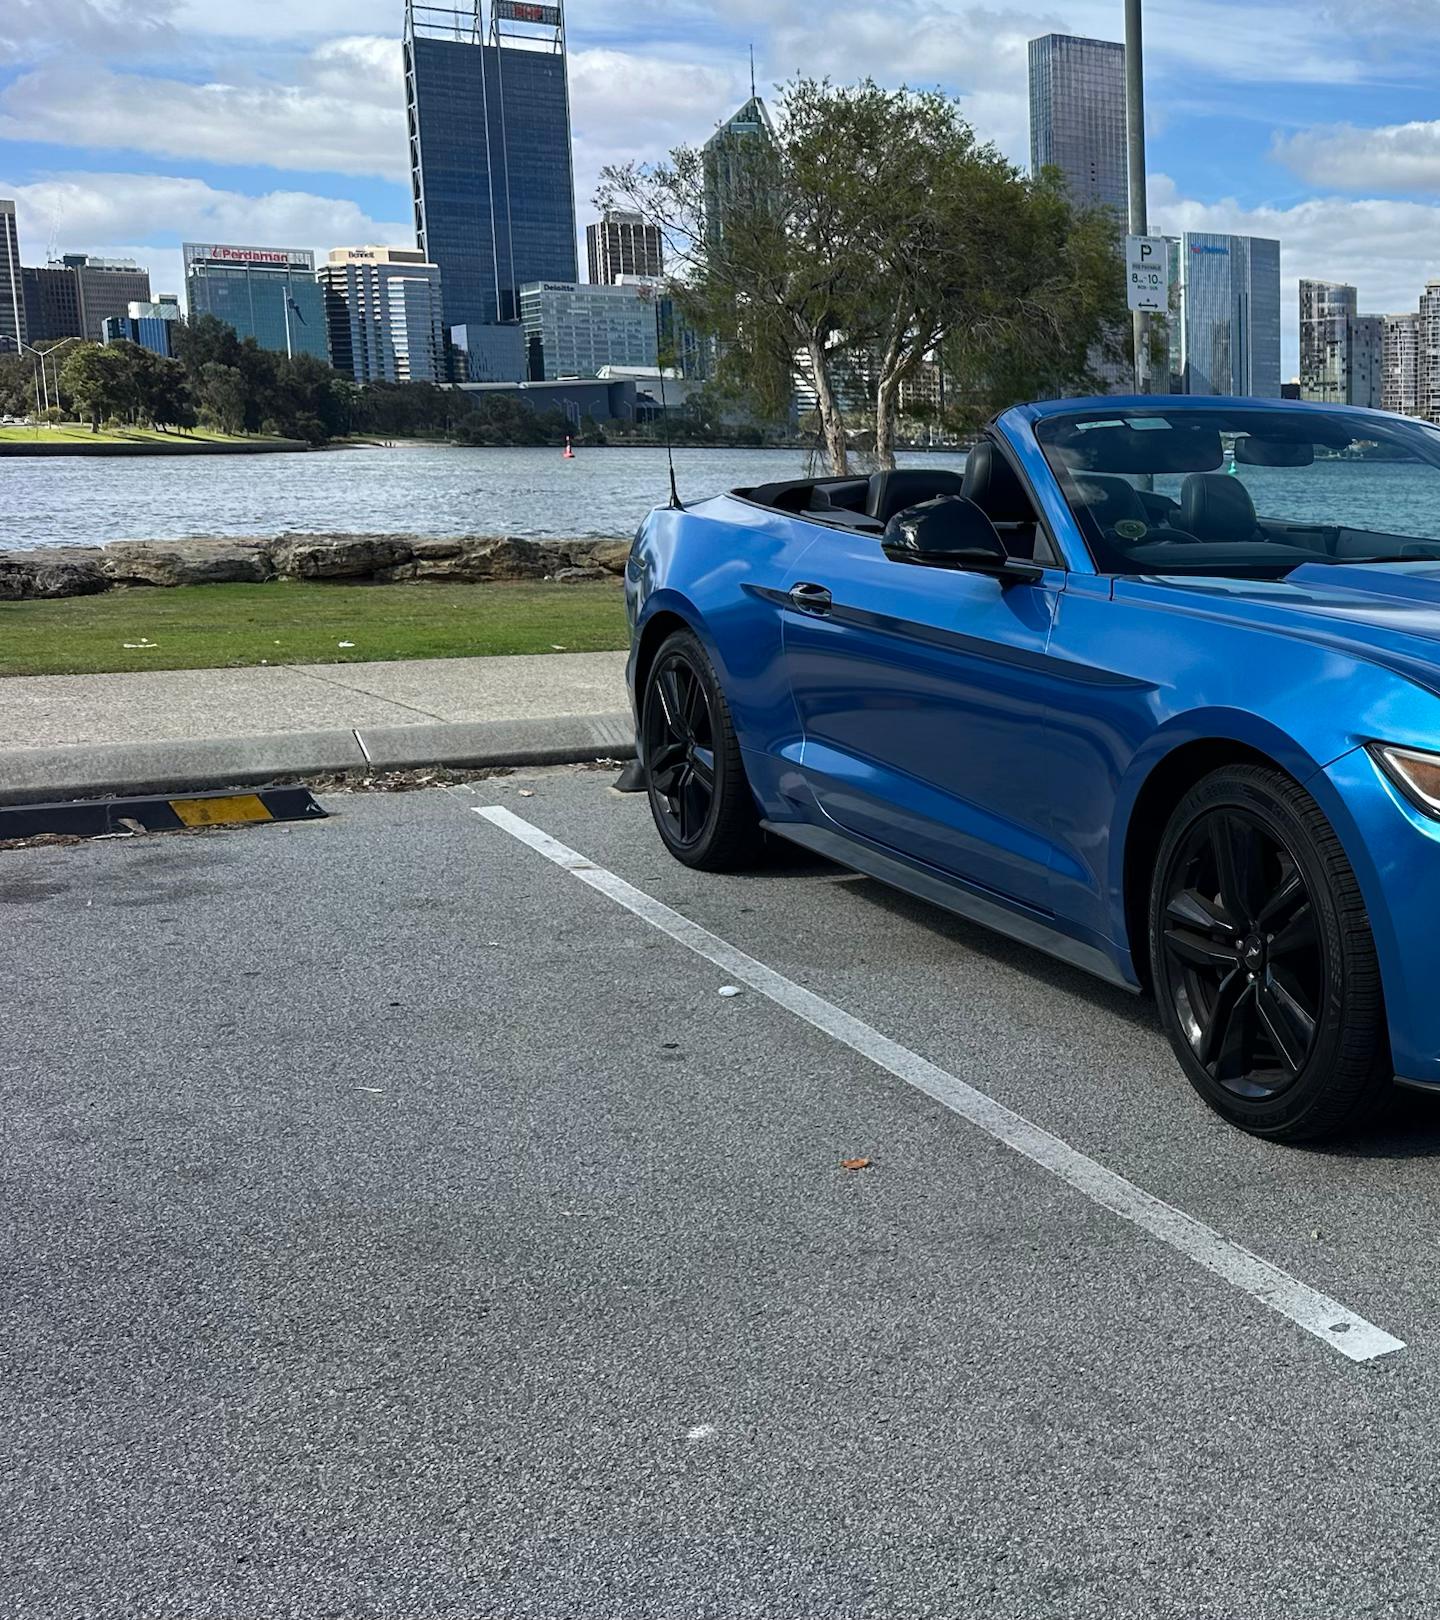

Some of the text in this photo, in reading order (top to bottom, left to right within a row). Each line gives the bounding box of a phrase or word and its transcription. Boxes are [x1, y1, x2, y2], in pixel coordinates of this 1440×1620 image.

[222, 249, 288, 262] Perdaman
[1141, 244, 1152, 262] P
[544, 284, 575, 292] Deloitte
